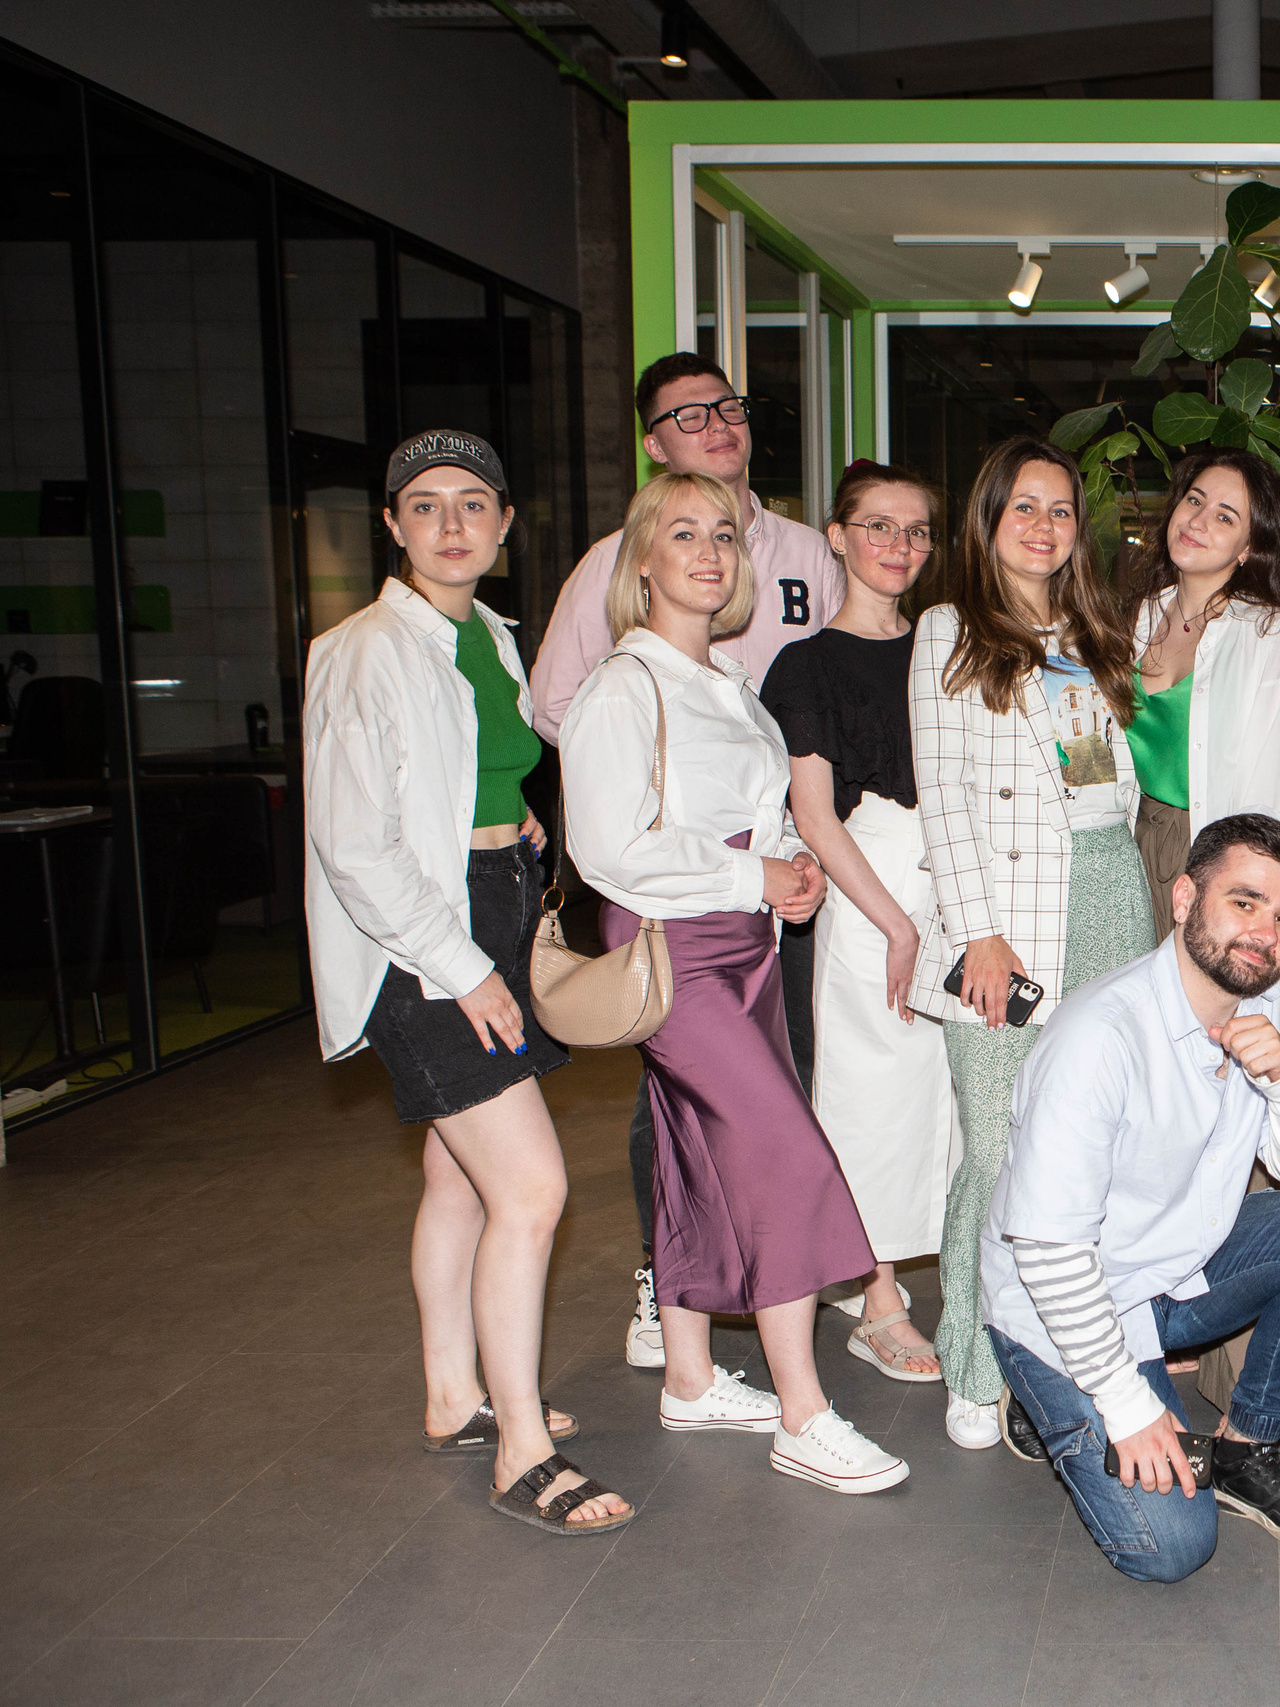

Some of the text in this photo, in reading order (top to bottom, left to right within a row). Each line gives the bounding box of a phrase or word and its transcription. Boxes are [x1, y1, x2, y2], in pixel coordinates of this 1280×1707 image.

[401, 433, 485, 466] NEW YORK
[777, 578, 811, 627] B
